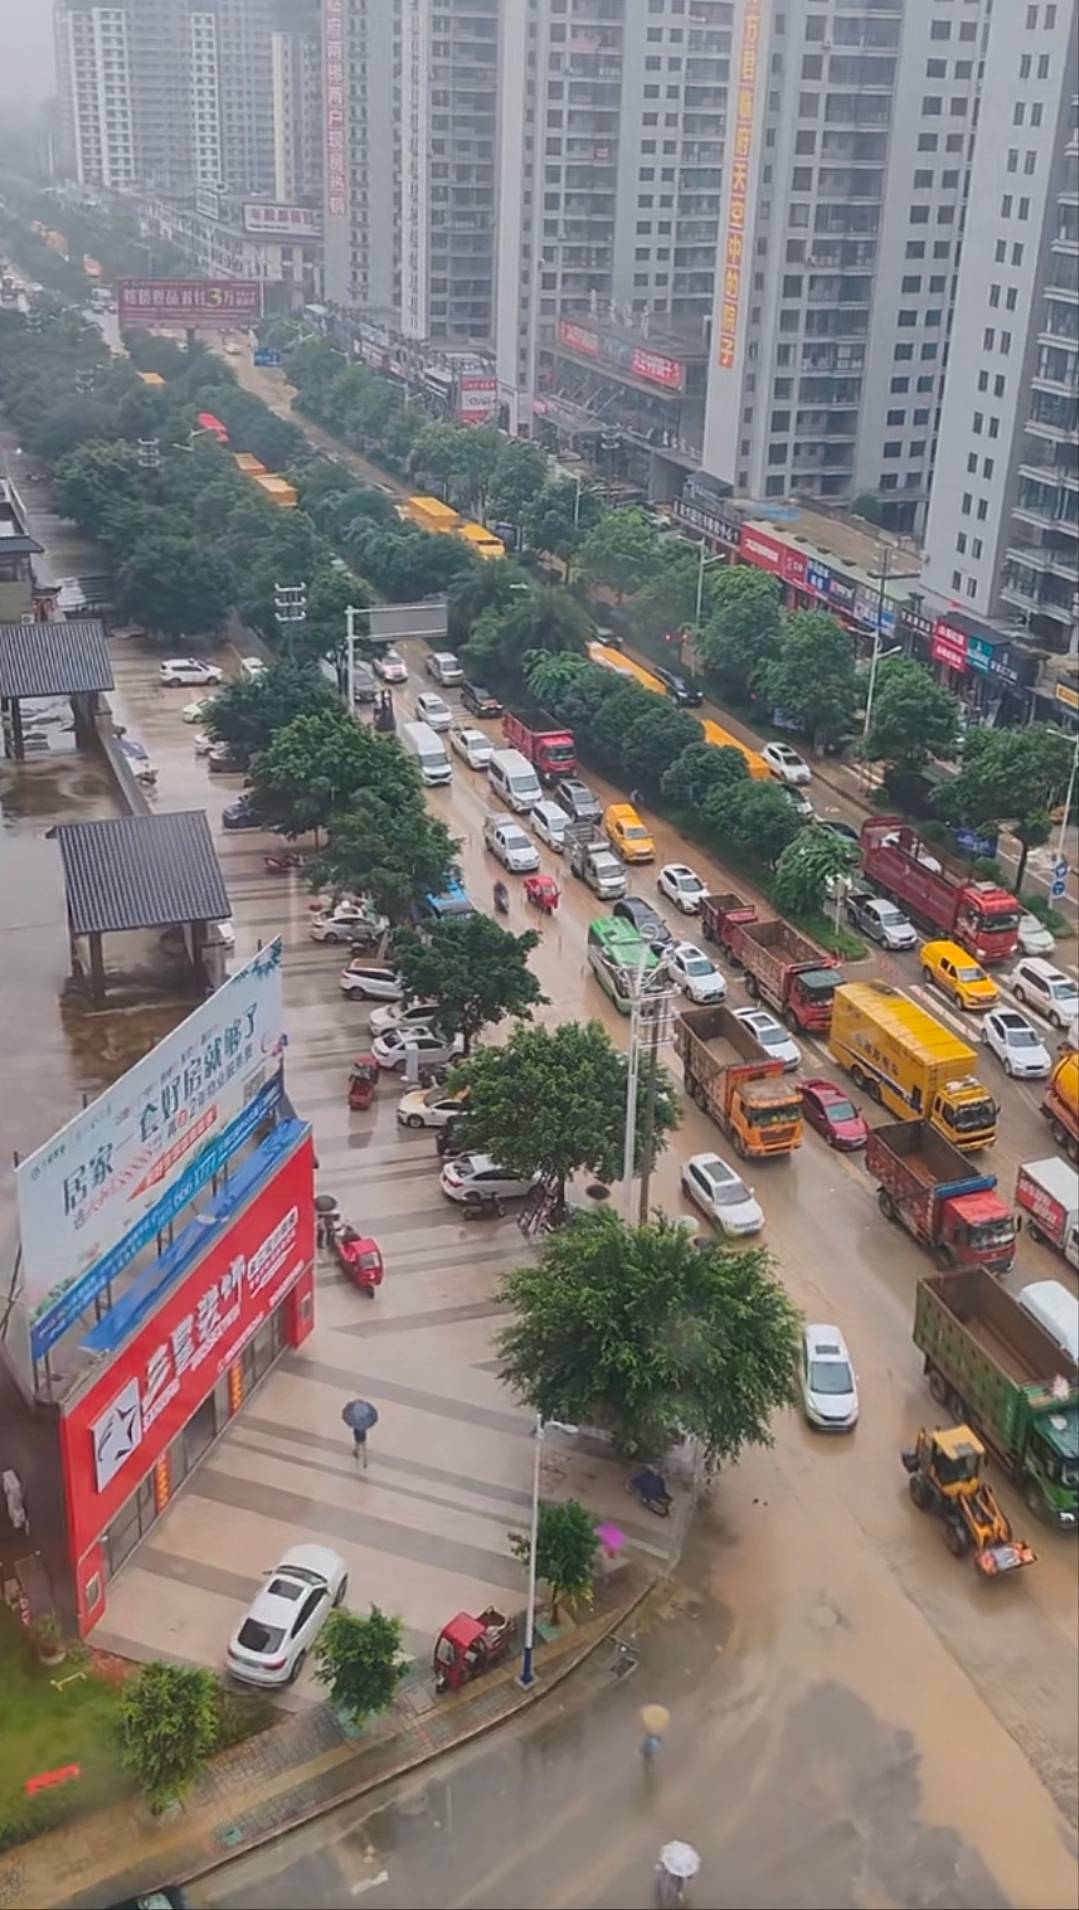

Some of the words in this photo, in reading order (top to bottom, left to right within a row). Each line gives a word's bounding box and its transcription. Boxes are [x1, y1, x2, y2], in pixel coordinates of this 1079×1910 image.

[63, 1001, 258, 1217] 居家一套好房就够了
